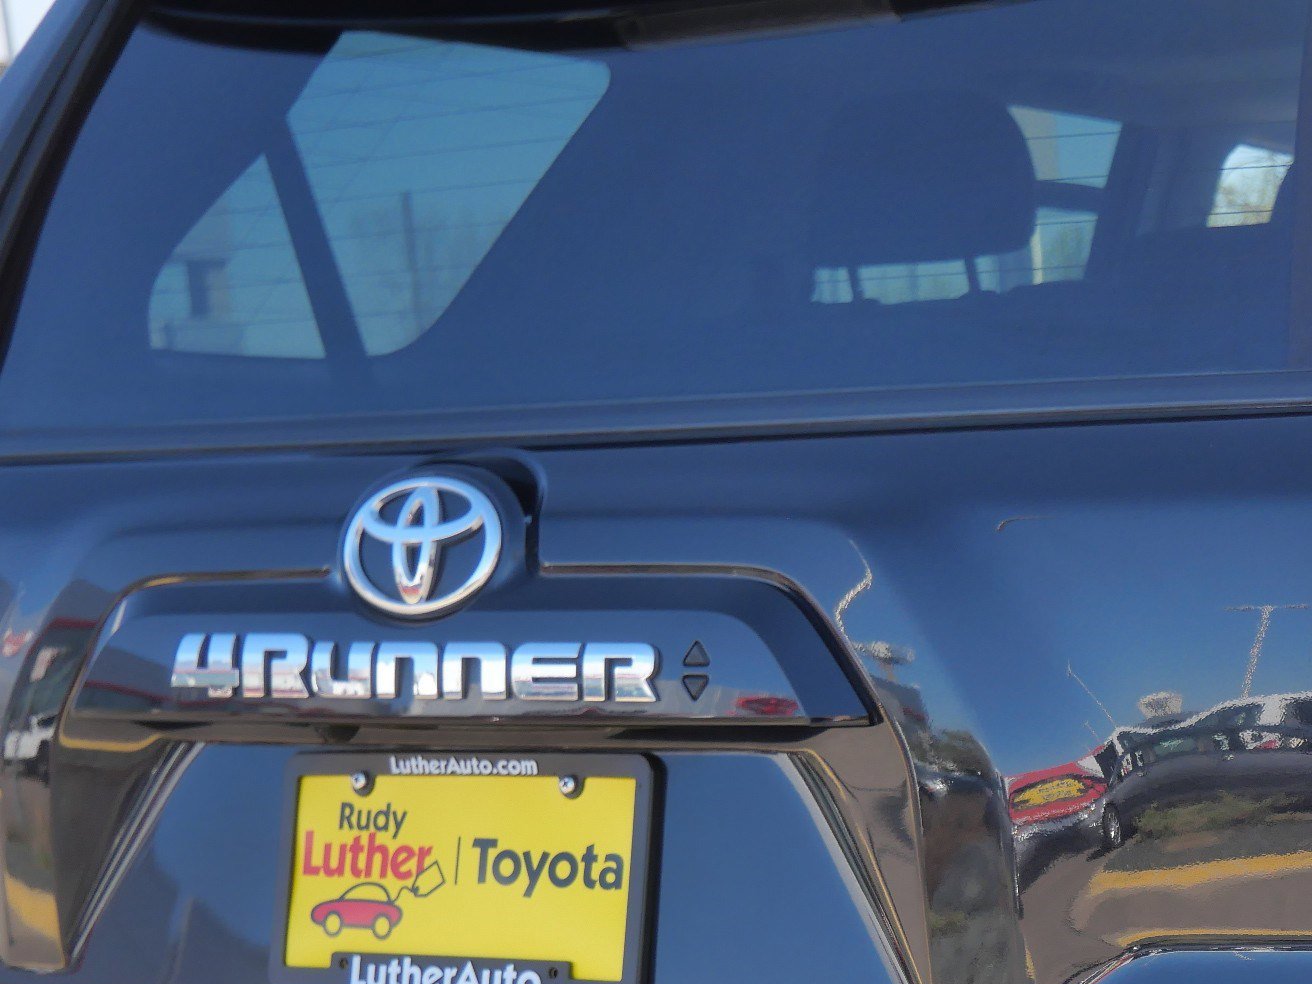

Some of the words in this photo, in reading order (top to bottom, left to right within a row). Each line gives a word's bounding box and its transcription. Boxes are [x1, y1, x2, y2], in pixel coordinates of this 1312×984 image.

[170, 632, 657, 702] 4RUNNER
[389, 755, 539, 776] LutherAuto.com
[338, 802, 408, 839] Rudy
[302, 830, 434, 880] Luther
[471, 838, 625, 898] Toyota
